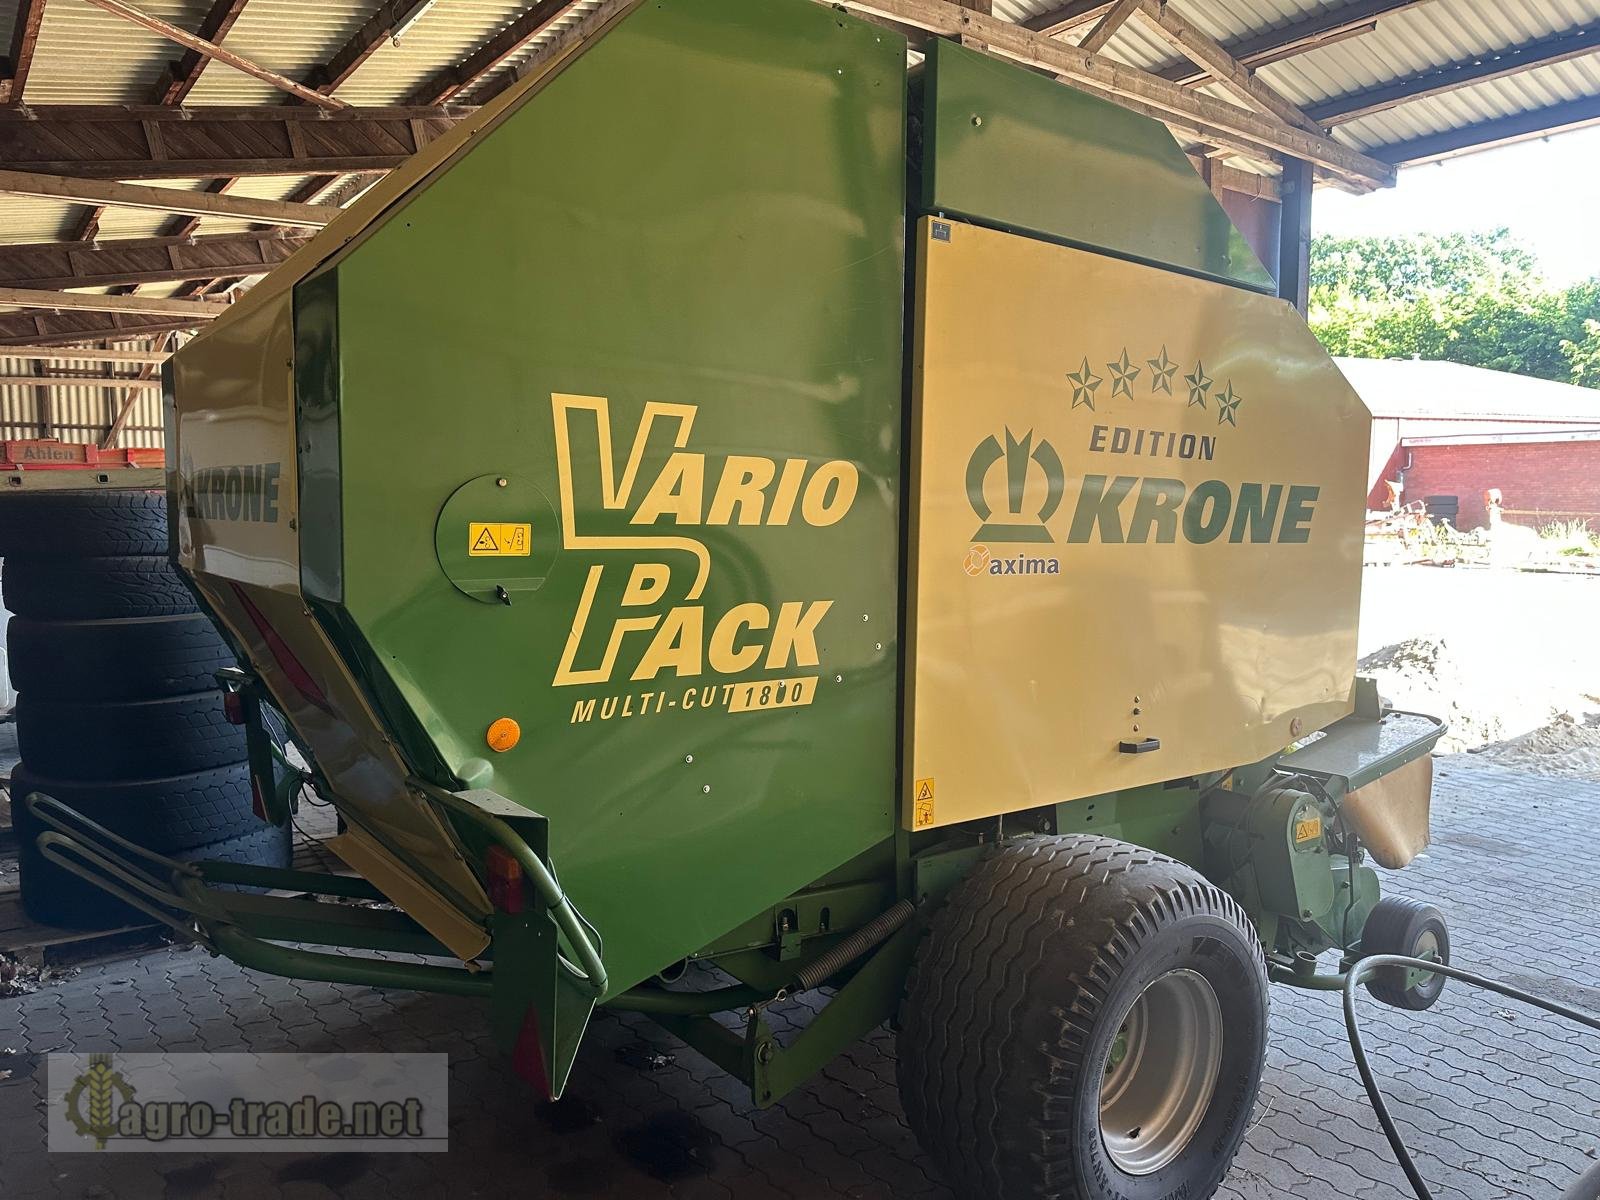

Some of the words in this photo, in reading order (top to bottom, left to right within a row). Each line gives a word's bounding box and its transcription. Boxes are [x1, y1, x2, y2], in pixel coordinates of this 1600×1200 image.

[24, 446, 74, 460] Ahlen
[551, 393, 859, 540] VARIO
[1089, 424, 1217, 461] EDITION
[199, 462, 280, 523] KRONE
[1066, 474, 1321, 544] KRONE
[989, 554, 1060, 576] axima
[552, 536, 834, 686] PACK
[570, 683, 735, 724] MULTI-CUT
[745, 682, 803, 708] 1800
